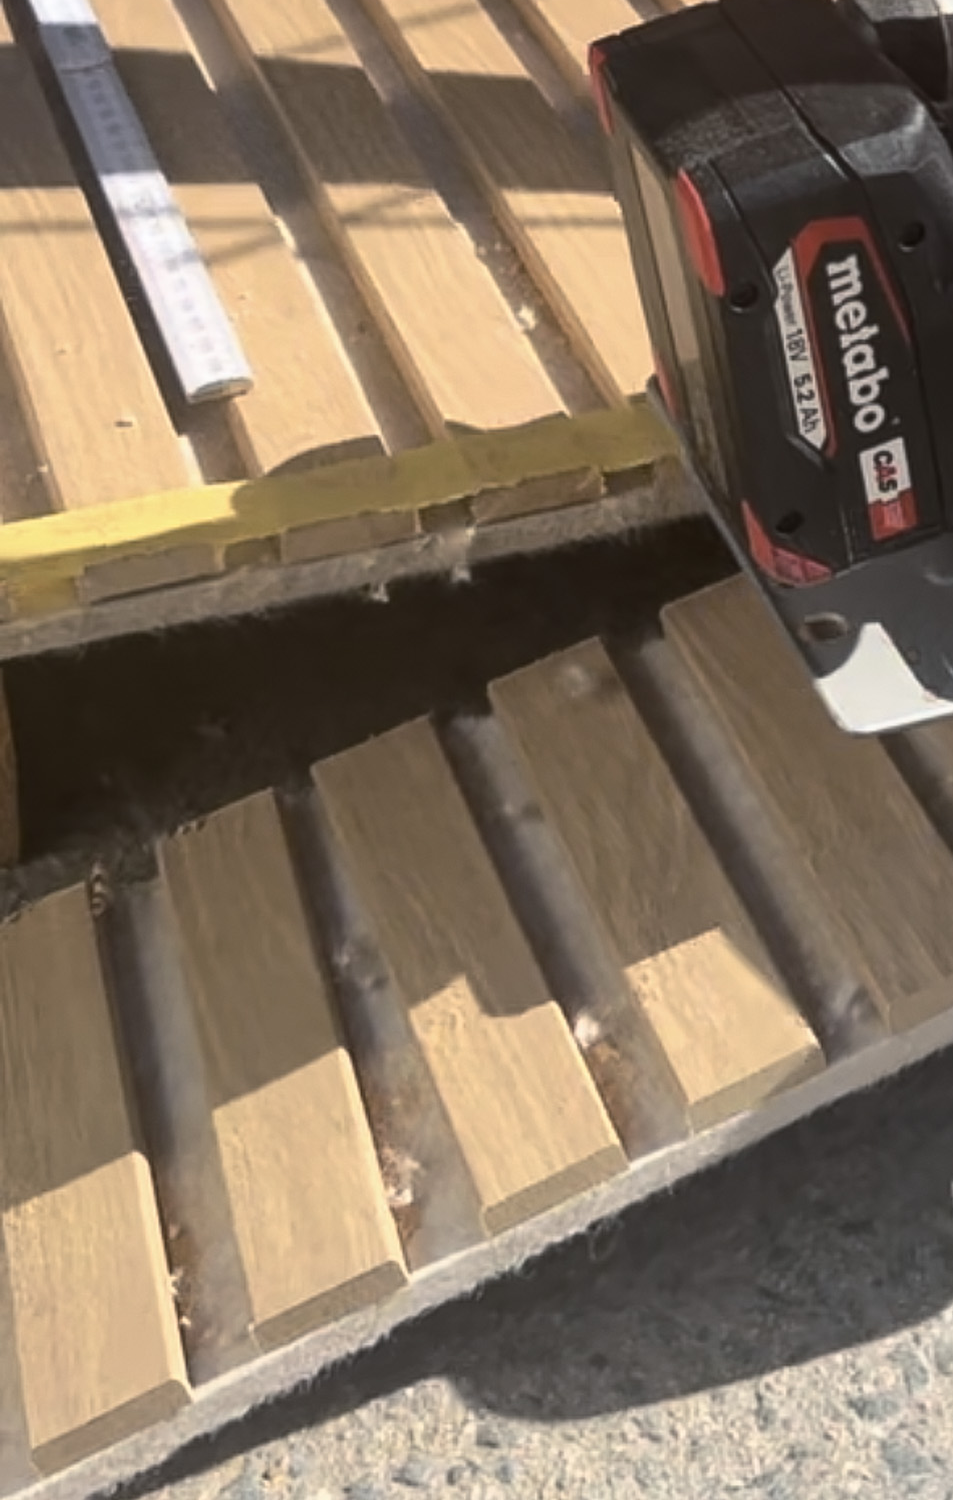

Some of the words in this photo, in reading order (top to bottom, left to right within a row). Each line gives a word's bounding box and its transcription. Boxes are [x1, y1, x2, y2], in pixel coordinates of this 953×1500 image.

[785, 328, 808, 362] 18V
[799, 406, 822, 434] Ah
[826, 254, 889, 433] metabo
[872, 449, 898, 494] CAS
